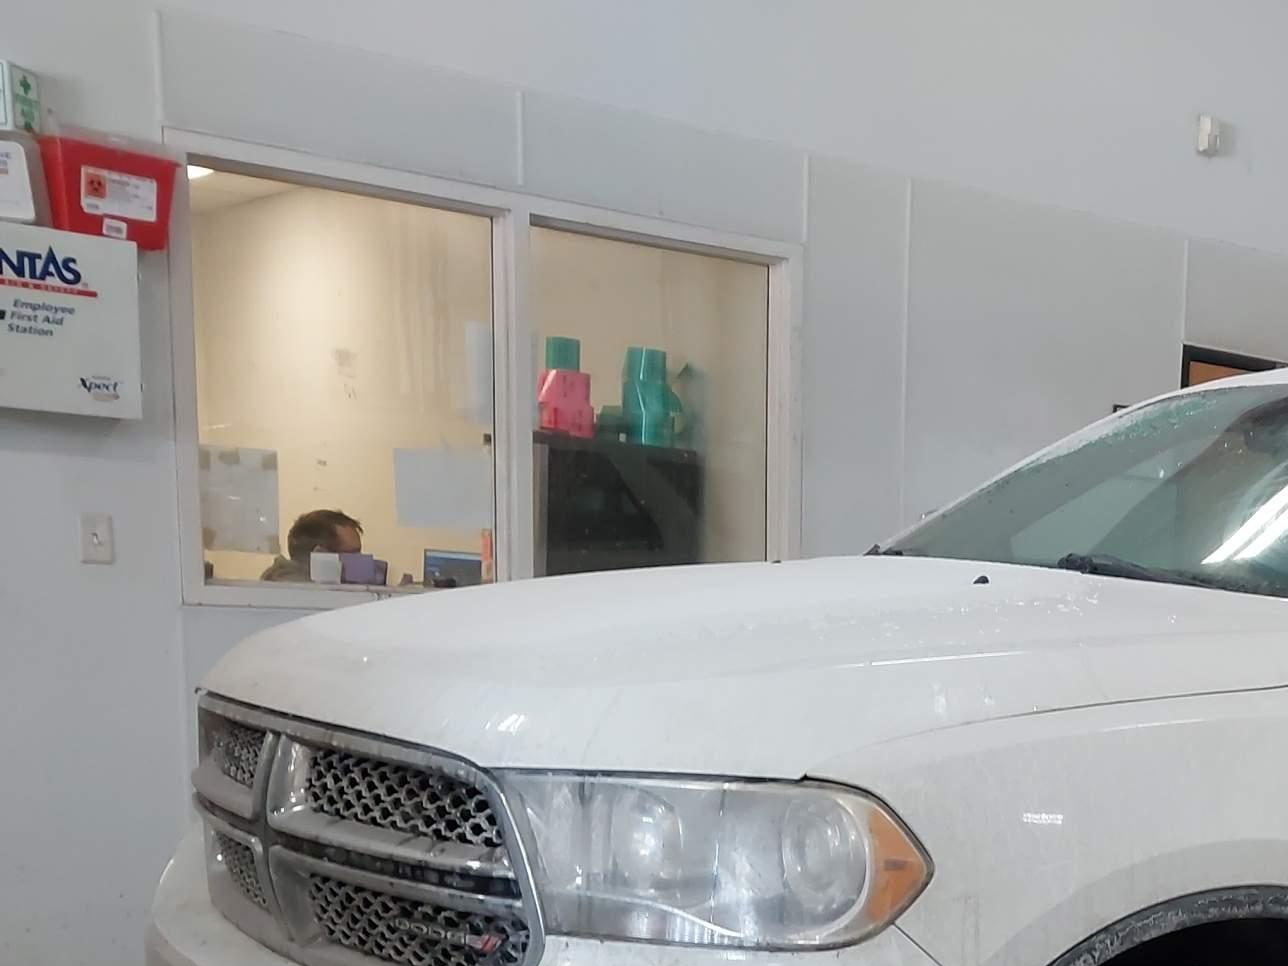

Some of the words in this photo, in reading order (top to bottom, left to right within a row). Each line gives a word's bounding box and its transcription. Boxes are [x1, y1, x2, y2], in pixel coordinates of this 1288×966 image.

[13, 299, 76, 315] Employee
[10, 311, 38, 323] First
[42, 315, 64, 326] Aid
[8, 323, 54, 336] Station
